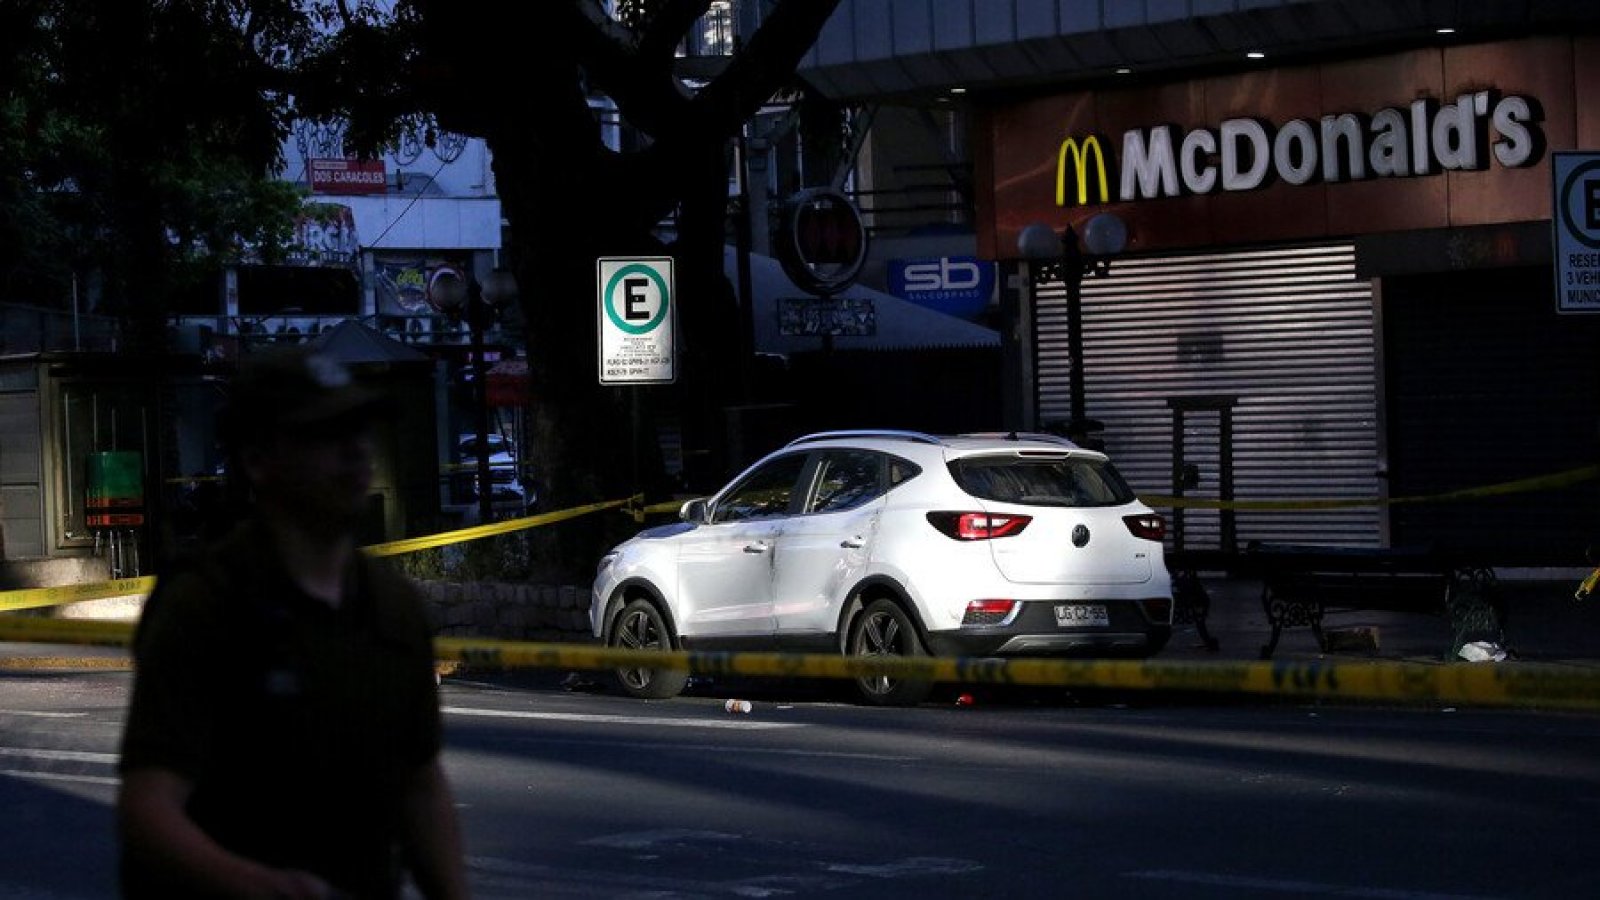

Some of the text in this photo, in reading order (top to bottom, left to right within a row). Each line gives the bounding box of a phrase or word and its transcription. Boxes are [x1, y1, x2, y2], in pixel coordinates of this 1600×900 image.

[1120, 91, 1536, 201] McDonald's
[314, 170, 332, 183] DOS
[1569, 253, 1600, 268] RESE
[1566, 271, 1574, 286] 3
[624, 278, 650, 320] E
